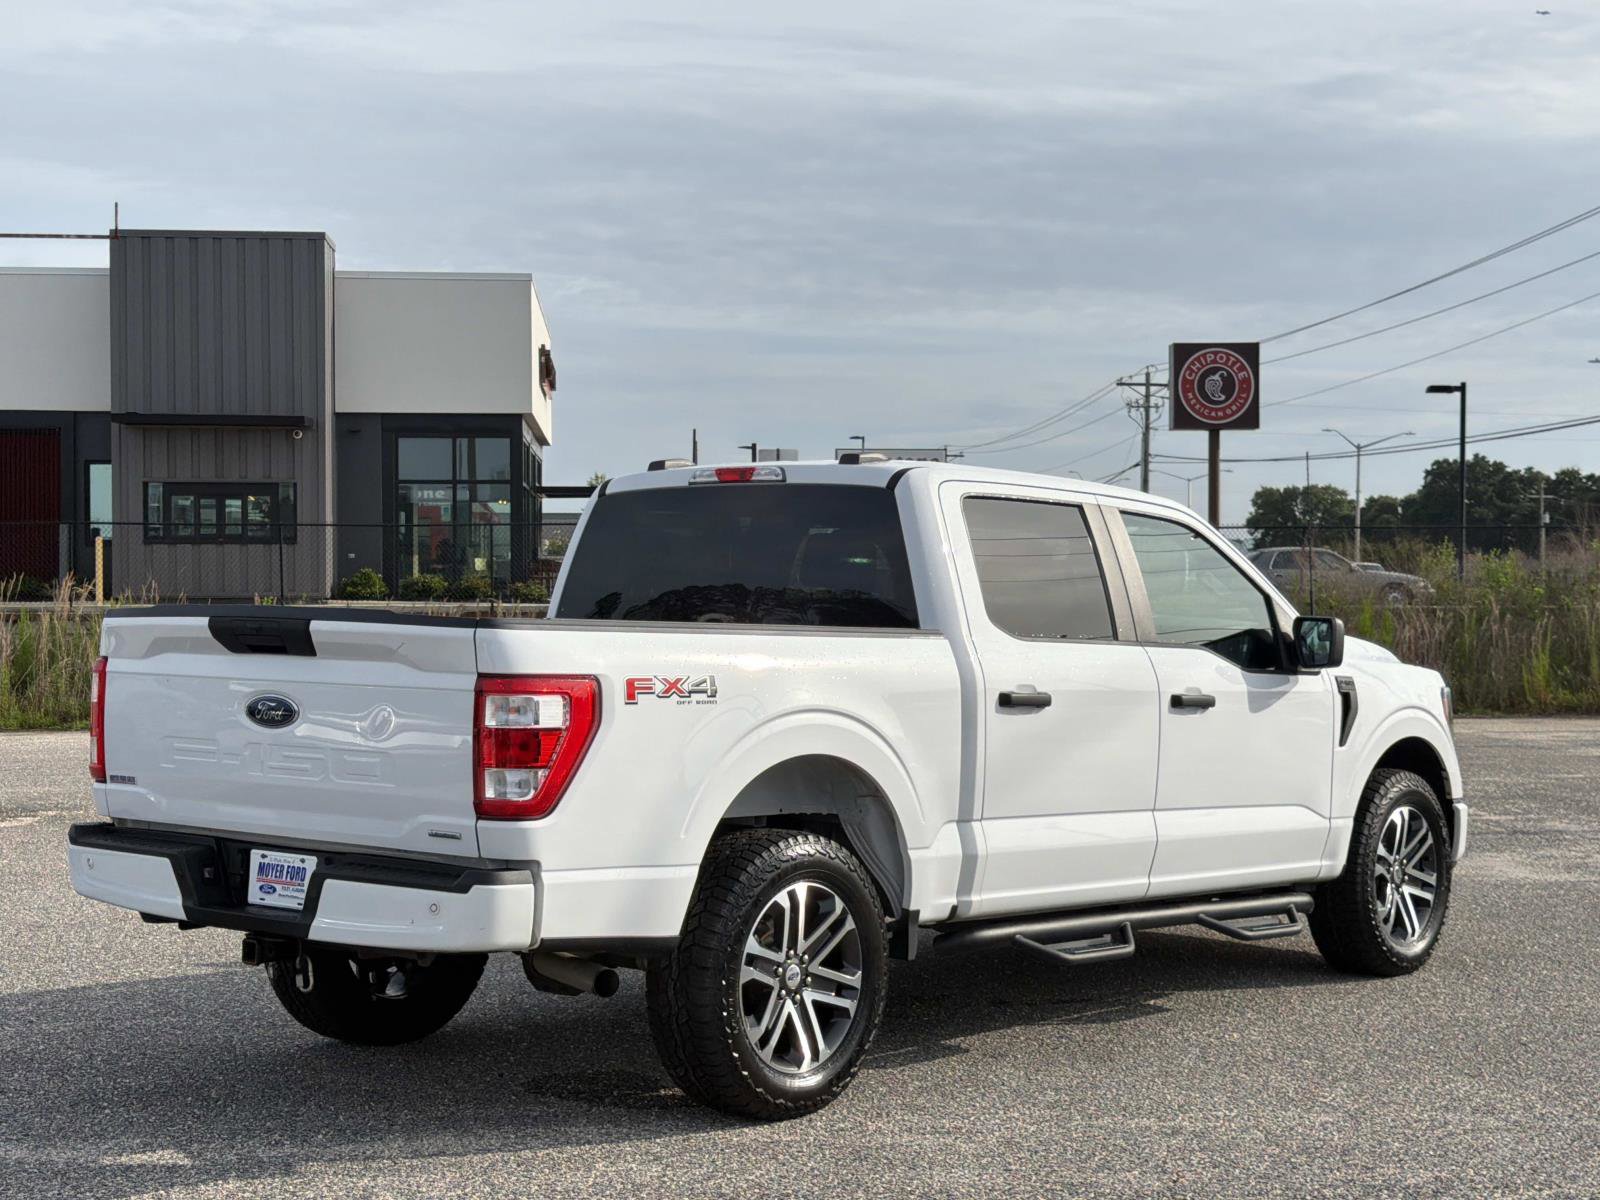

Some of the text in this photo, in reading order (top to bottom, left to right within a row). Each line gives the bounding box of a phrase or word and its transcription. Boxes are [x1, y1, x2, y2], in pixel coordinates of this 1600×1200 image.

[1185, 353, 1248, 380] CHIPOTLE
[1187, 392, 1248, 417] MEXICAN GRILL
[624, 674, 717, 705] FX4
[257, 861, 307, 883] MOYER FORD
